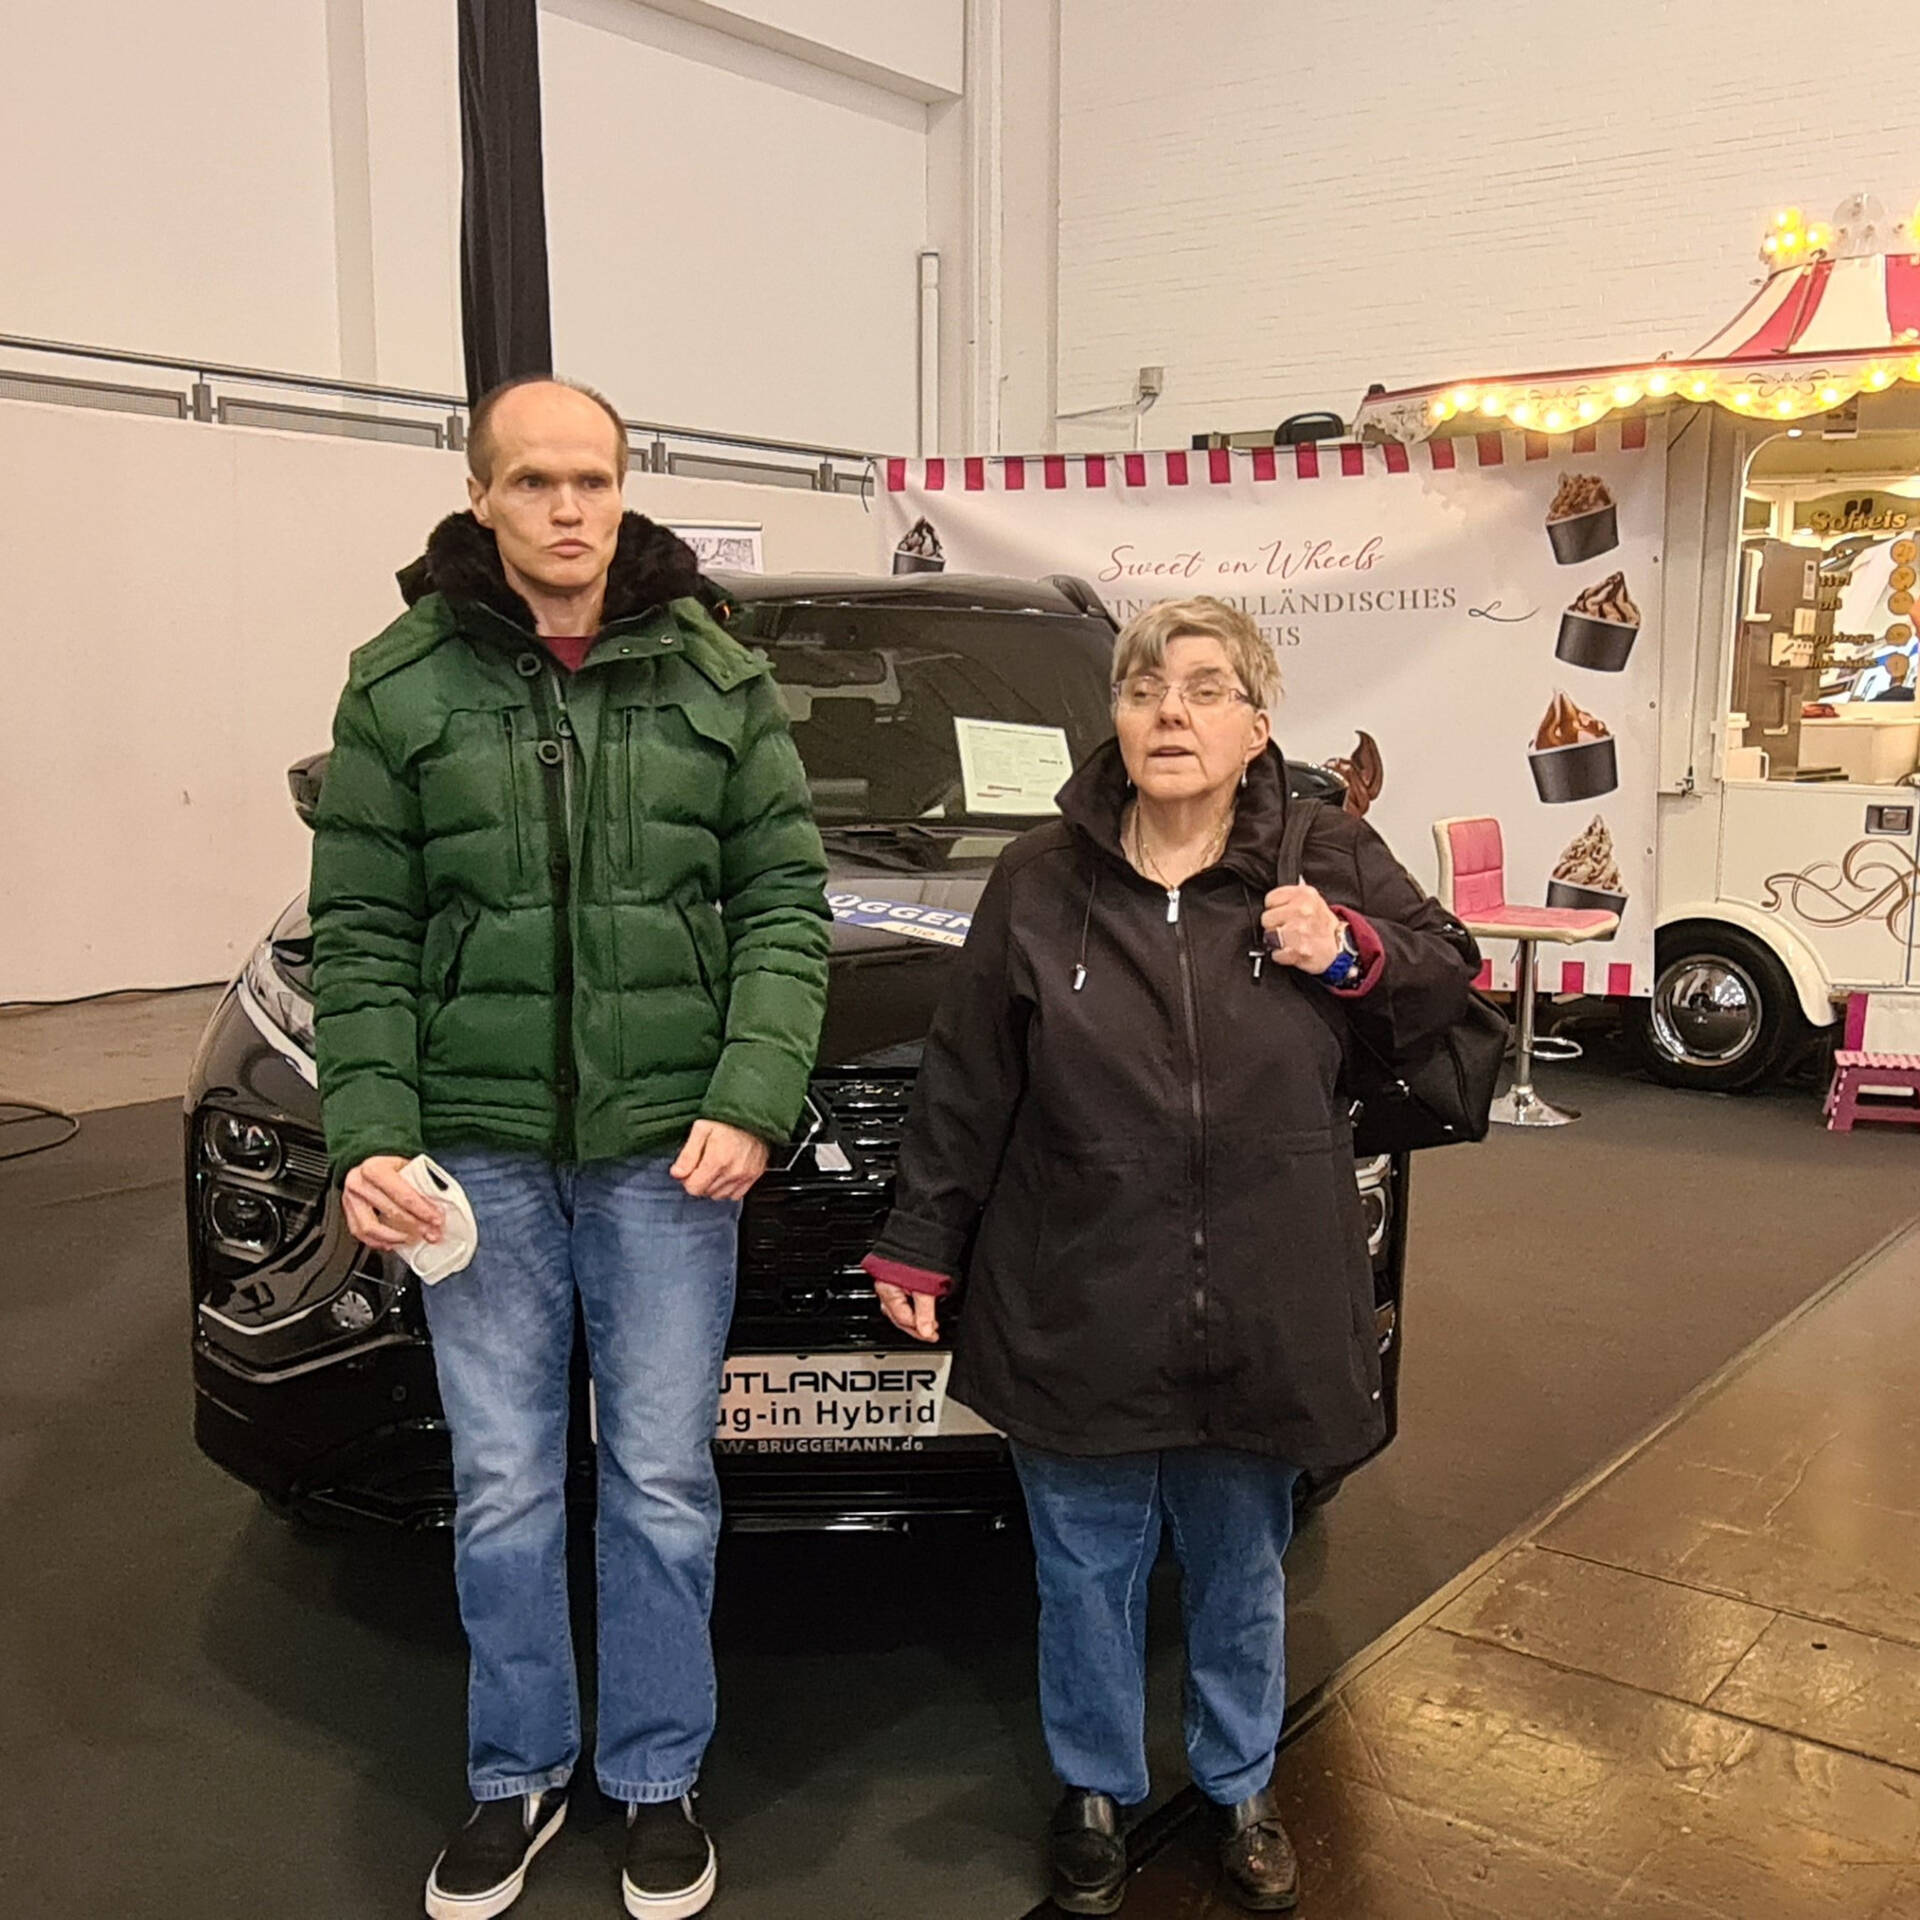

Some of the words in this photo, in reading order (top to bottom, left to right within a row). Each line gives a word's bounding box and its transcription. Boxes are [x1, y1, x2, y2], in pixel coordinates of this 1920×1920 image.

[1809, 509, 1908, 532] Softeis
[1098, 544, 1205, 583] Sweet
[1217, 560, 1259, 575] on
[1258, 536, 1385, 580] Wheels
[816, 1399, 935, 1431] Hybrid
